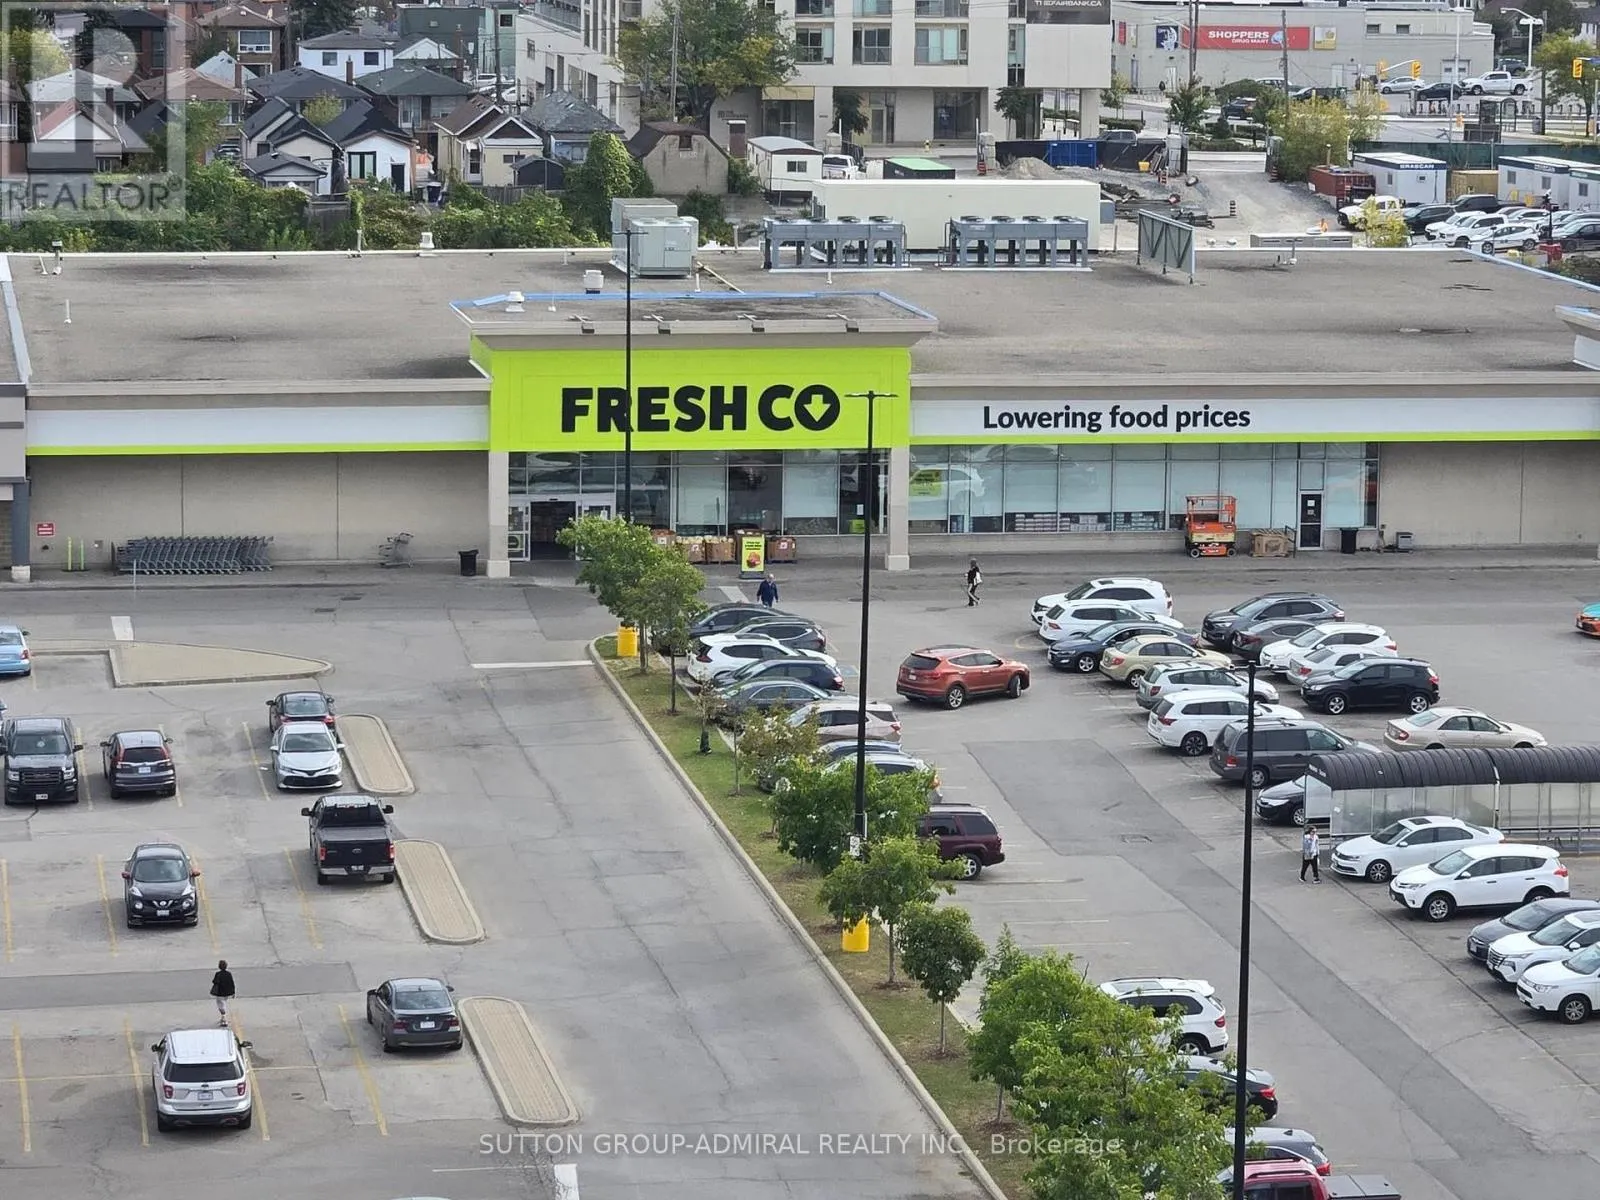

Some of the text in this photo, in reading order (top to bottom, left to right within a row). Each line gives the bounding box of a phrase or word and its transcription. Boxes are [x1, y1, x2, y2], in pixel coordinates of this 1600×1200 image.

[1208, 30, 1270, 39] SHOPPERS
[983, 404, 1251, 433] Lowering food prices
